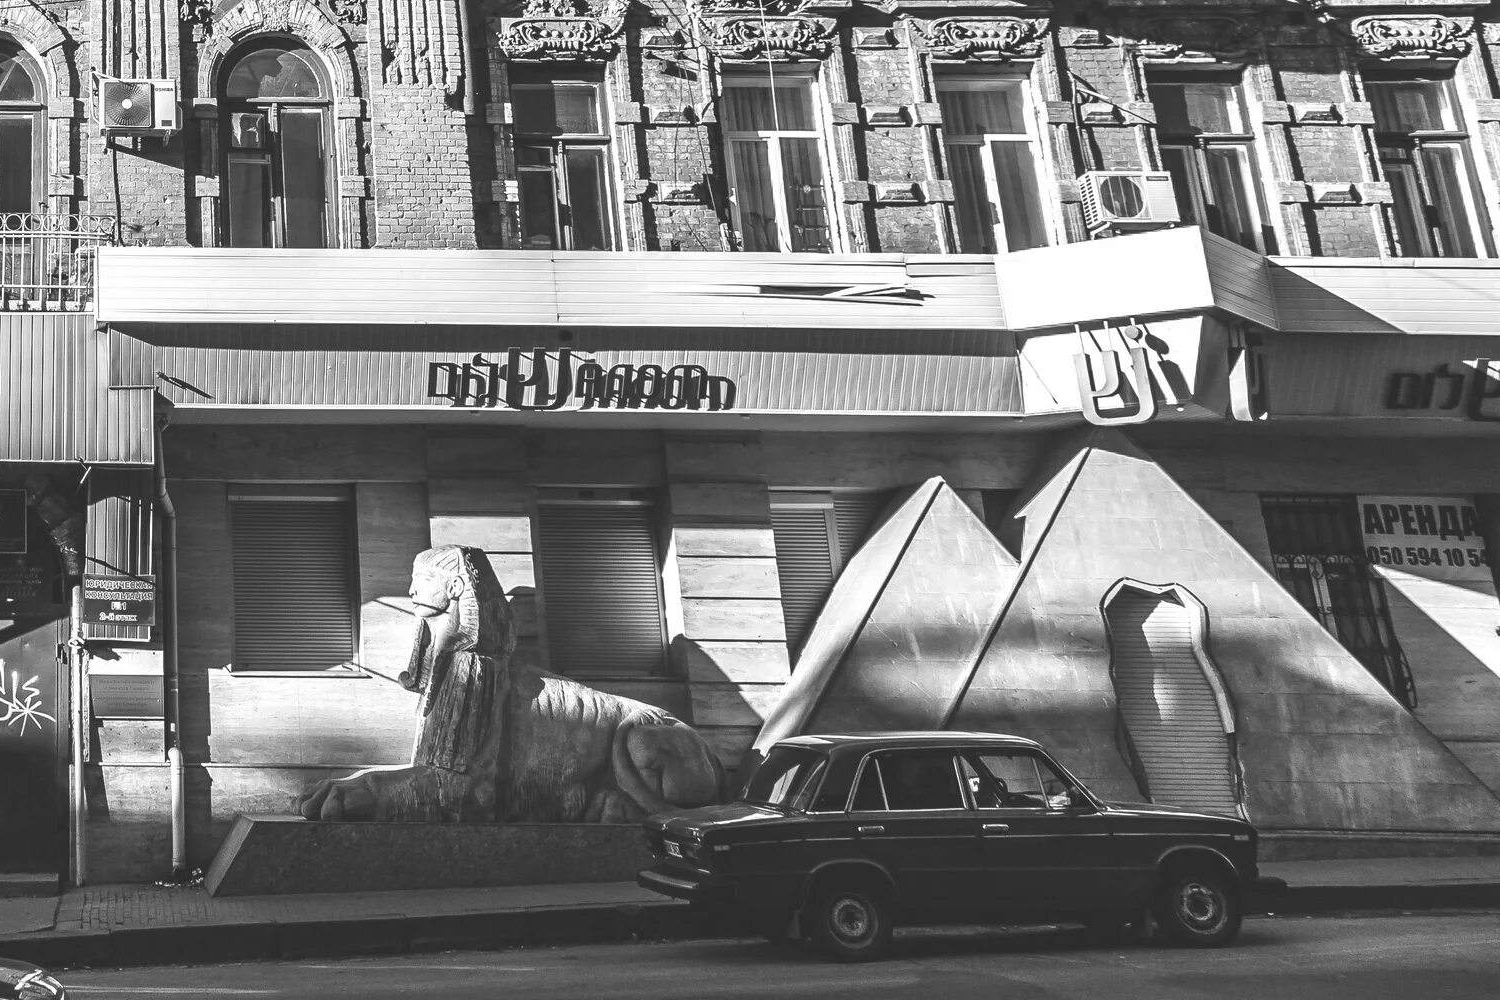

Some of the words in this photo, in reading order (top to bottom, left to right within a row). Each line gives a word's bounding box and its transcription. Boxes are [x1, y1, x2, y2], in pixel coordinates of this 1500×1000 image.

[1363, 504, 1480, 541] АРЕНДА
[1367, 546, 1404, 566] 050
[1405, 547, 1442, 567] 594
[1443, 549, 1465, 567] 10
[85, 579, 153, 590] ЮРИДИЧЕСКАЯ
[84, 590, 154, 602] КОНСУЛЬТАЦИЯ
